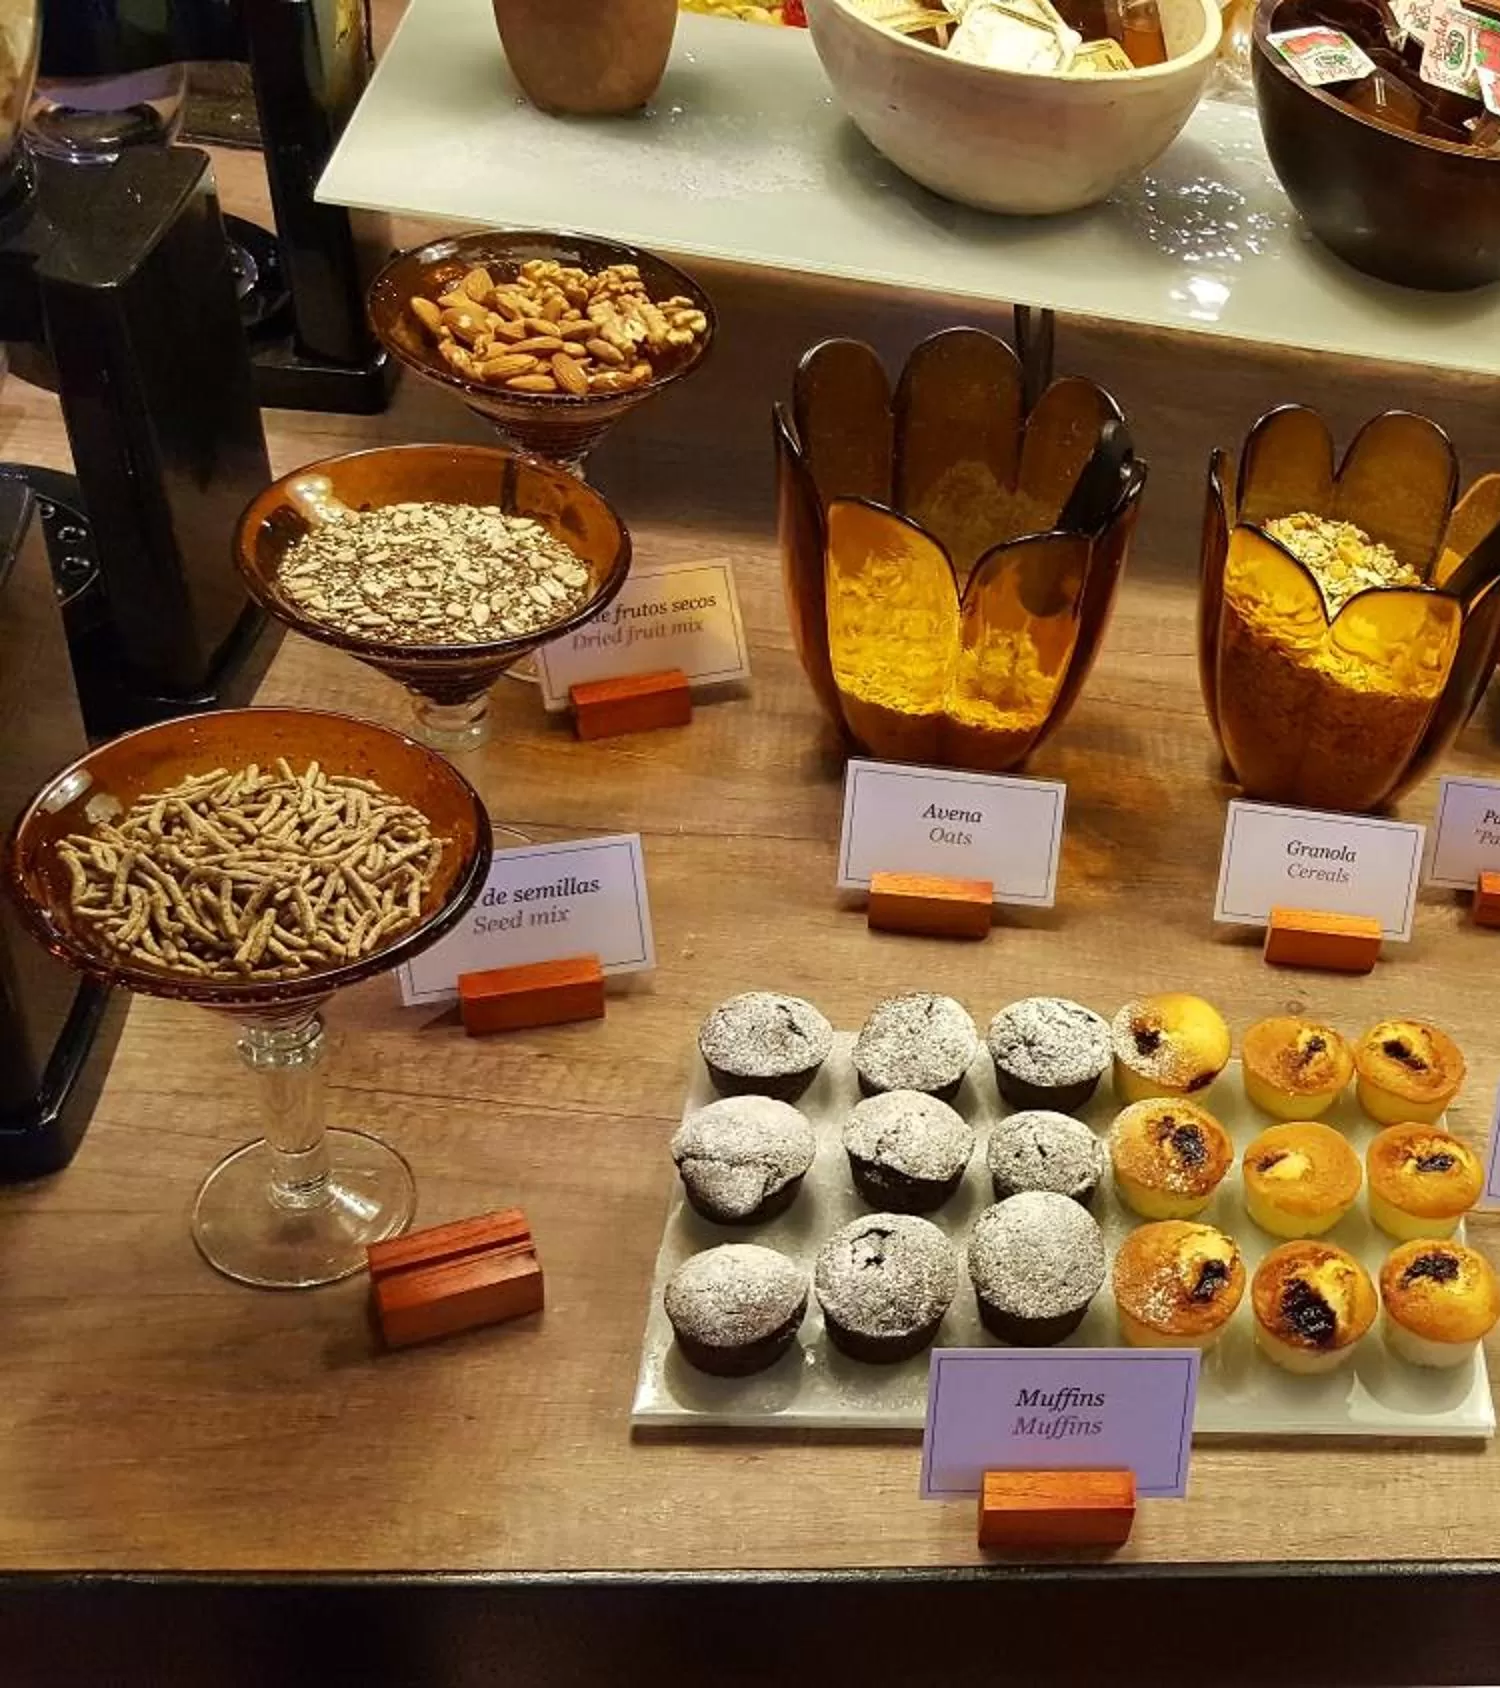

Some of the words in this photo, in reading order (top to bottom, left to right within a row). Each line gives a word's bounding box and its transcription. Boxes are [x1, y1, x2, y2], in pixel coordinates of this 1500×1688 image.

[613, 603, 667, 625] frutos
[670, 593, 717, 614] secos
[572, 631, 622, 650] Dried
[623, 624, 666, 648] fruit
[670, 617, 704, 636] mix
[922, 803, 983, 823] Avena
[928, 826, 973, 845] Oats
[1287, 839, 1357, 862] Granola
[1287, 863, 1350, 882] Cereals
[482, 887, 509, 907] de
[513, 876, 602, 904] semillas
[473, 911, 524, 935] Seed
[530, 904, 572, 926] mix
[1014, 1388, 1106, 1412] Muffins
[1012, 1416, 1104, 1440] Muffins
